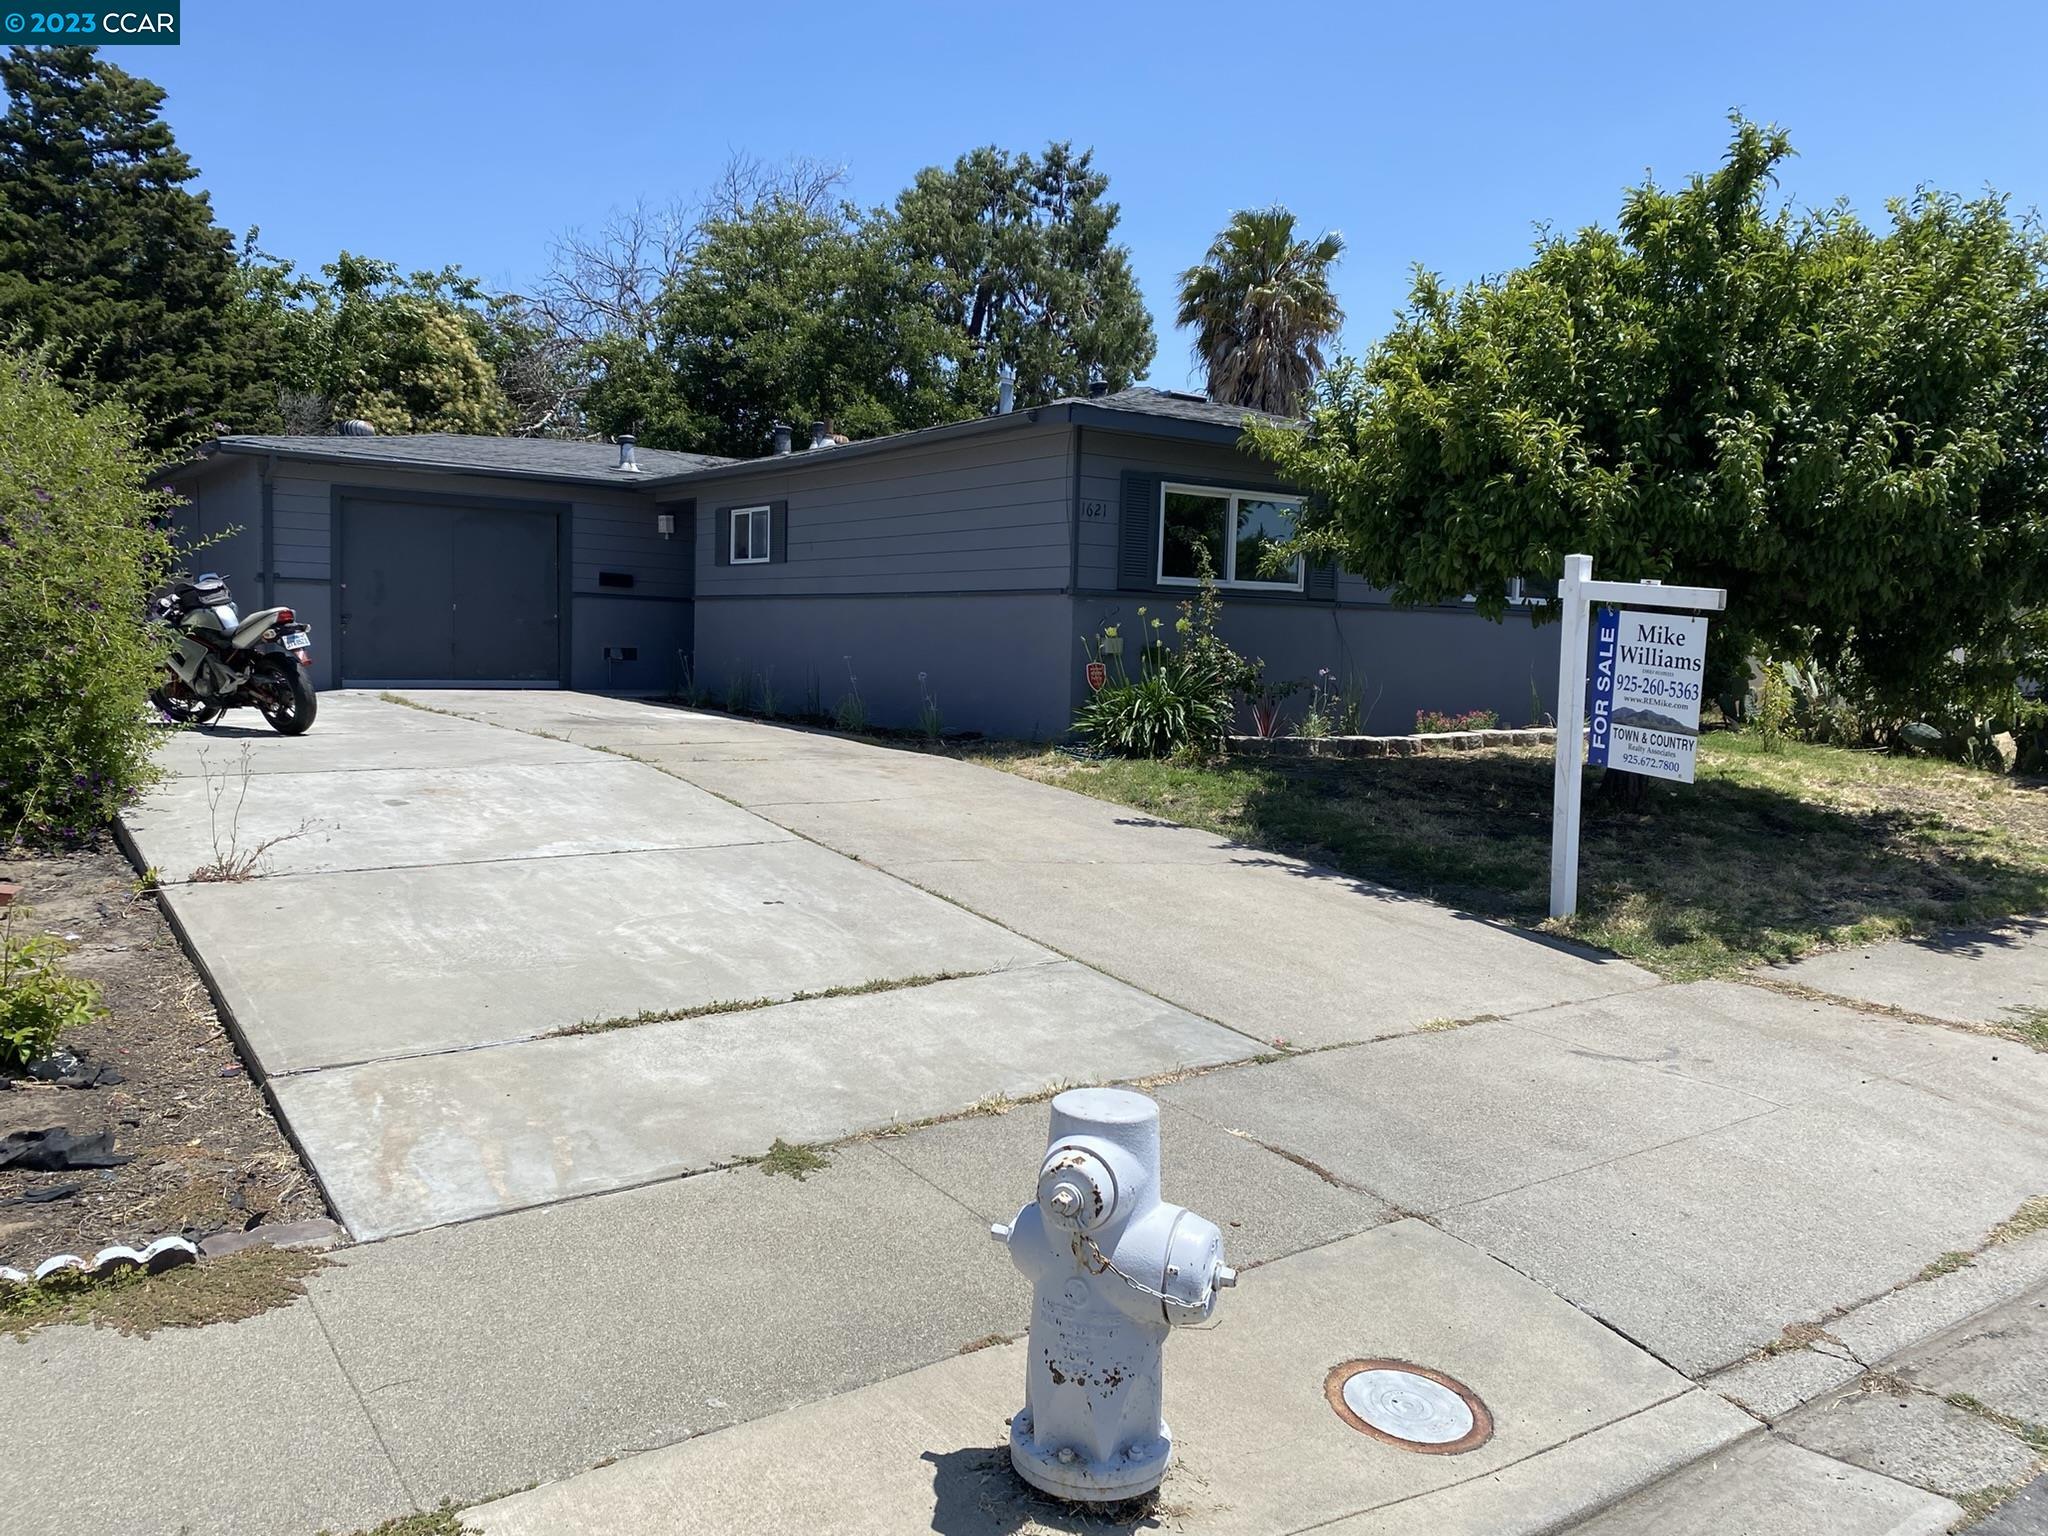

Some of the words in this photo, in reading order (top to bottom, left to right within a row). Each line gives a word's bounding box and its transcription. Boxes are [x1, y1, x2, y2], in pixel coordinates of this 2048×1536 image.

[1082, 502, 1107, 518] 1621
[1637, 624, 1686, 647] Mike
[1597, 628, 1615, 692] SALE
[1620, 645, 1701, 672] Williams
[1616, 674, 1699, 701] 925-260-5363
[1624, 695, 1689, 711] www.REMike.com
[1593, 699, 1609, 749] FOR
[1613, 727, 1639, 743] TOWN
[1641, 732, 1648, 744] &
[1650, 733, 1695, 752] COUNTRY
[1628, 743, 1646, 755] Realty
[1647, 746, 1676, 759] Associates
[1623, 754, 1680, 773] 925.672.7800
